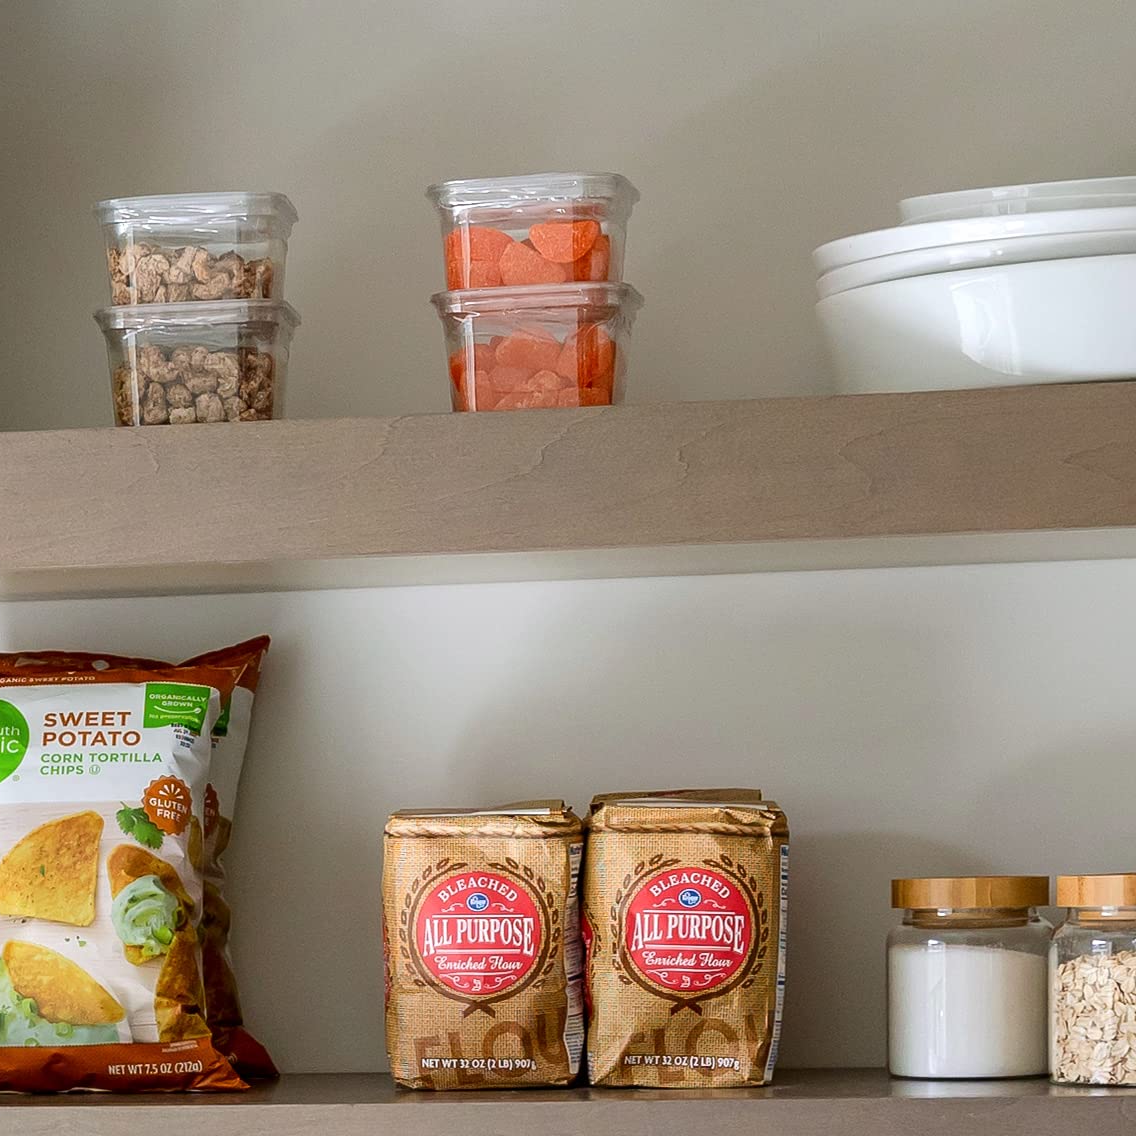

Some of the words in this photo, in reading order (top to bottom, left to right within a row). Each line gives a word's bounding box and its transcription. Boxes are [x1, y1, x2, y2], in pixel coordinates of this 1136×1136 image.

[149, 693, 207, 702] ORGANICALLY
[43, 711, 131, 728] SWEET
[42, 731, 141, 747] POTATO
[40, 753, 83, 764] CORN
[89, 752, 163, 763] TORTILLA
[40, 765, 84, 775] CHIPS
[149, 797, 188, 815] GLUTEN
[156, 808, 181, 822] FREE
[437, 876, 518, 902] BLEACHED
[649, 872, 731, 899] BLEACHED
[423, 918, 453, 957] ALL
[456, 917, 535, 956] PURPOSE
[630, 912, 663, 952] ALL
[666, 914, 745, 955] PURPOSE
[434, 956, 486, 970] Enriched
[489, 956, 524, 970] Flour
[642, 951, 696, 966] Enriched
[699, 952, 734, 968] Flour
[108, 1063, 125, 1075] NET
[127, 1063, 143, 1075] WT
[145, 1063, 158, 1075] 7.5
[160, 1063, 173, 1074] OZ
[421, 1058, 440, 1069] NET
[441, 1058, 458, 1069] WT
[459, 1058, 470, 1069] 32
[473, 1058, 486, 1069] OZ
[487, 1058, 497, 1071] (2
[498, 1058, 513, 1071] LB)
[514, 1058, 537, 1071] 907g
[624, 1055, 641, 1066] NET
[643, 1055, 660, 1066] WT
[662, 1055, 672, 1066] 32
[674, 1055, 688, 1067] OZ
[690, 1055, 700, 1069] (2
[701, 1056, 716, 1070] LB)
[717, 1057, 740, 1071] 907g
